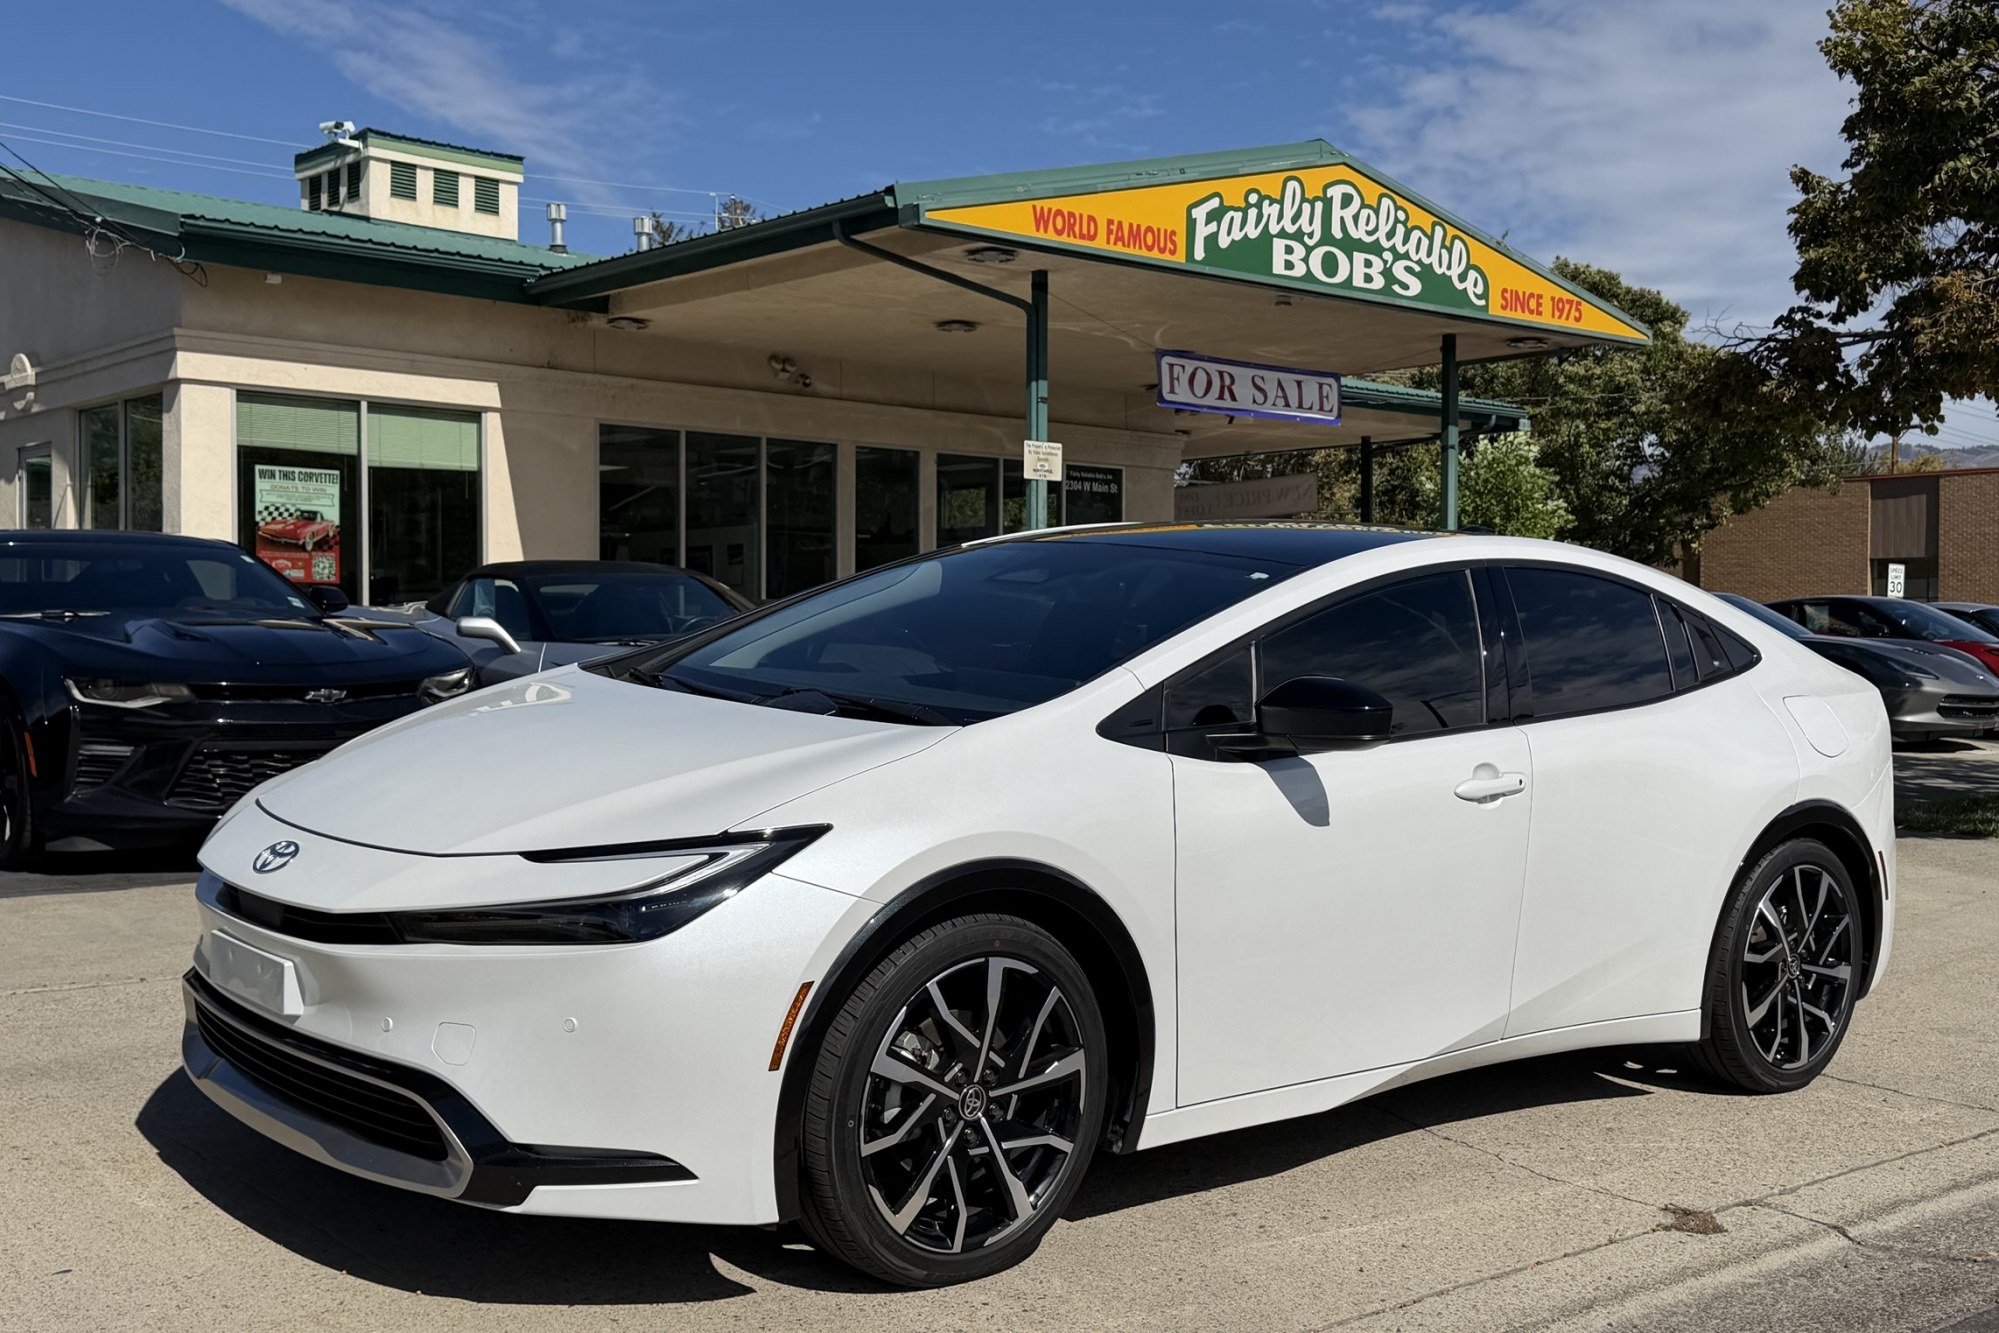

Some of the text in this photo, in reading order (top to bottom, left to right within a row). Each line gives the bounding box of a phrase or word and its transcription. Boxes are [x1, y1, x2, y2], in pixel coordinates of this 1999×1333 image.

[1032, 204, 1178, 256] WORLD FAMOUS
[1191, 180, 1486, 306] Fairly Reliable
[1272, 237, 1422, 297] BOB'S
[1500, 287, 1583, 323] SINCE 1975
[1165, 362, 1334, 413] FOR SALE
[258, 468, 339, 485] WIN THIS CORVETTE!
[1064, 479, 1118, 493] 2304 W Main St
[1889, 580, 1902, 594] 30
